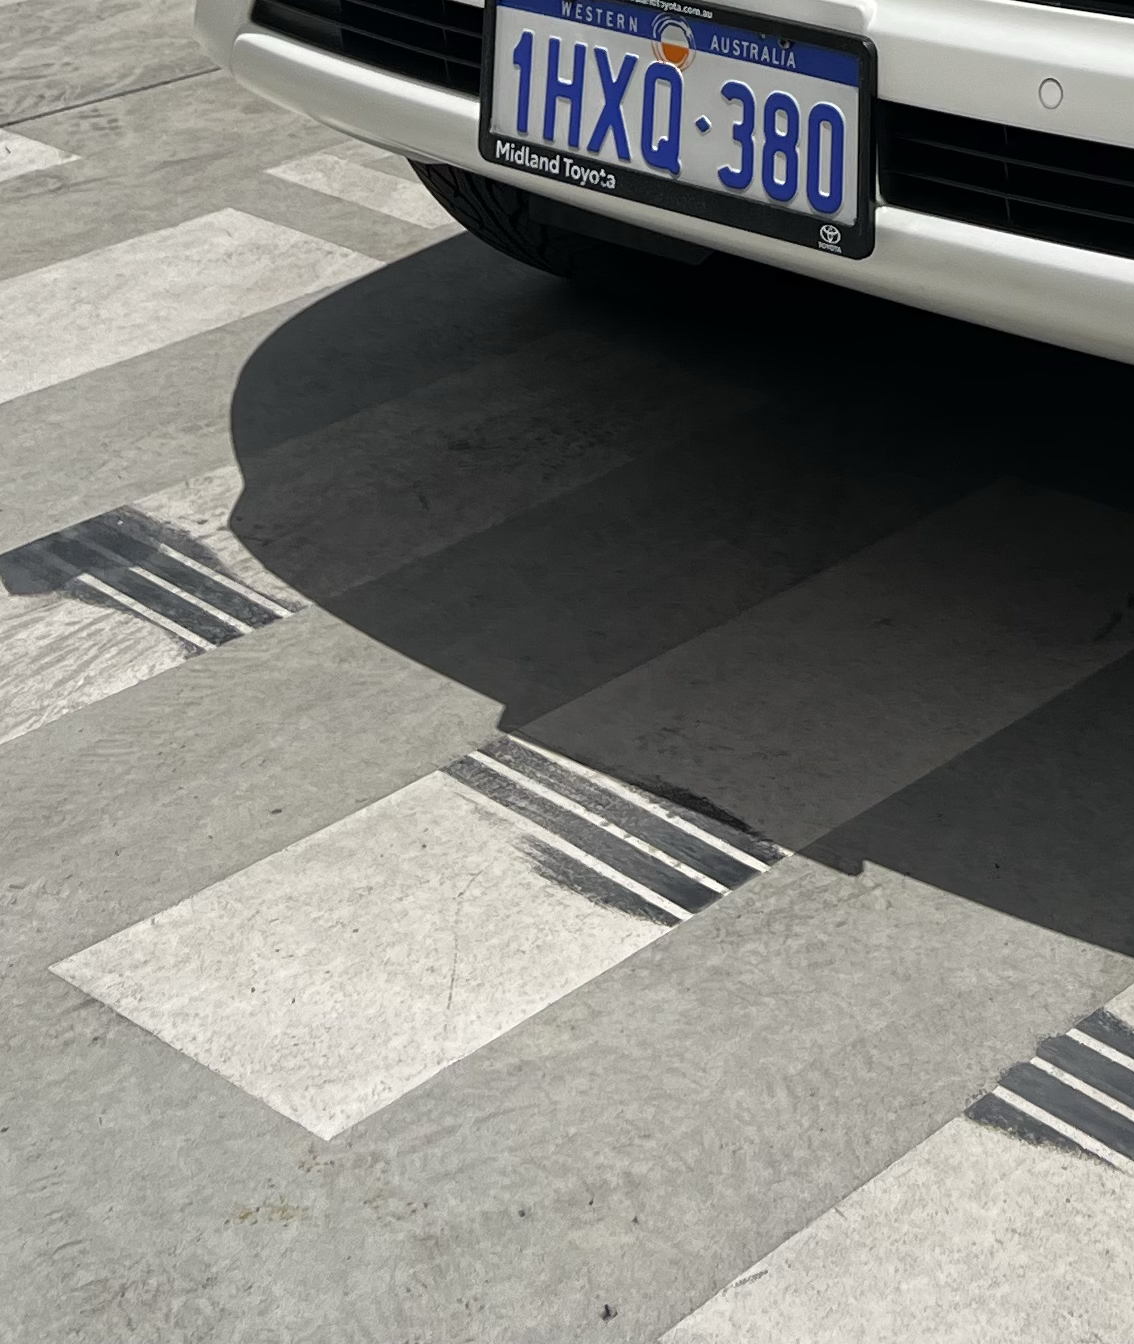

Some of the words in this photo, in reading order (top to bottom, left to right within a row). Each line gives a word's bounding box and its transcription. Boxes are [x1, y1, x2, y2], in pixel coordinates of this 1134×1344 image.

[561, 0, 638, 33] WESTERN
[710, 34, 796, 69] AUSTRALIA
[495, 139, 560, 175] Midland
[563, 157, 616, 189] Toyota
